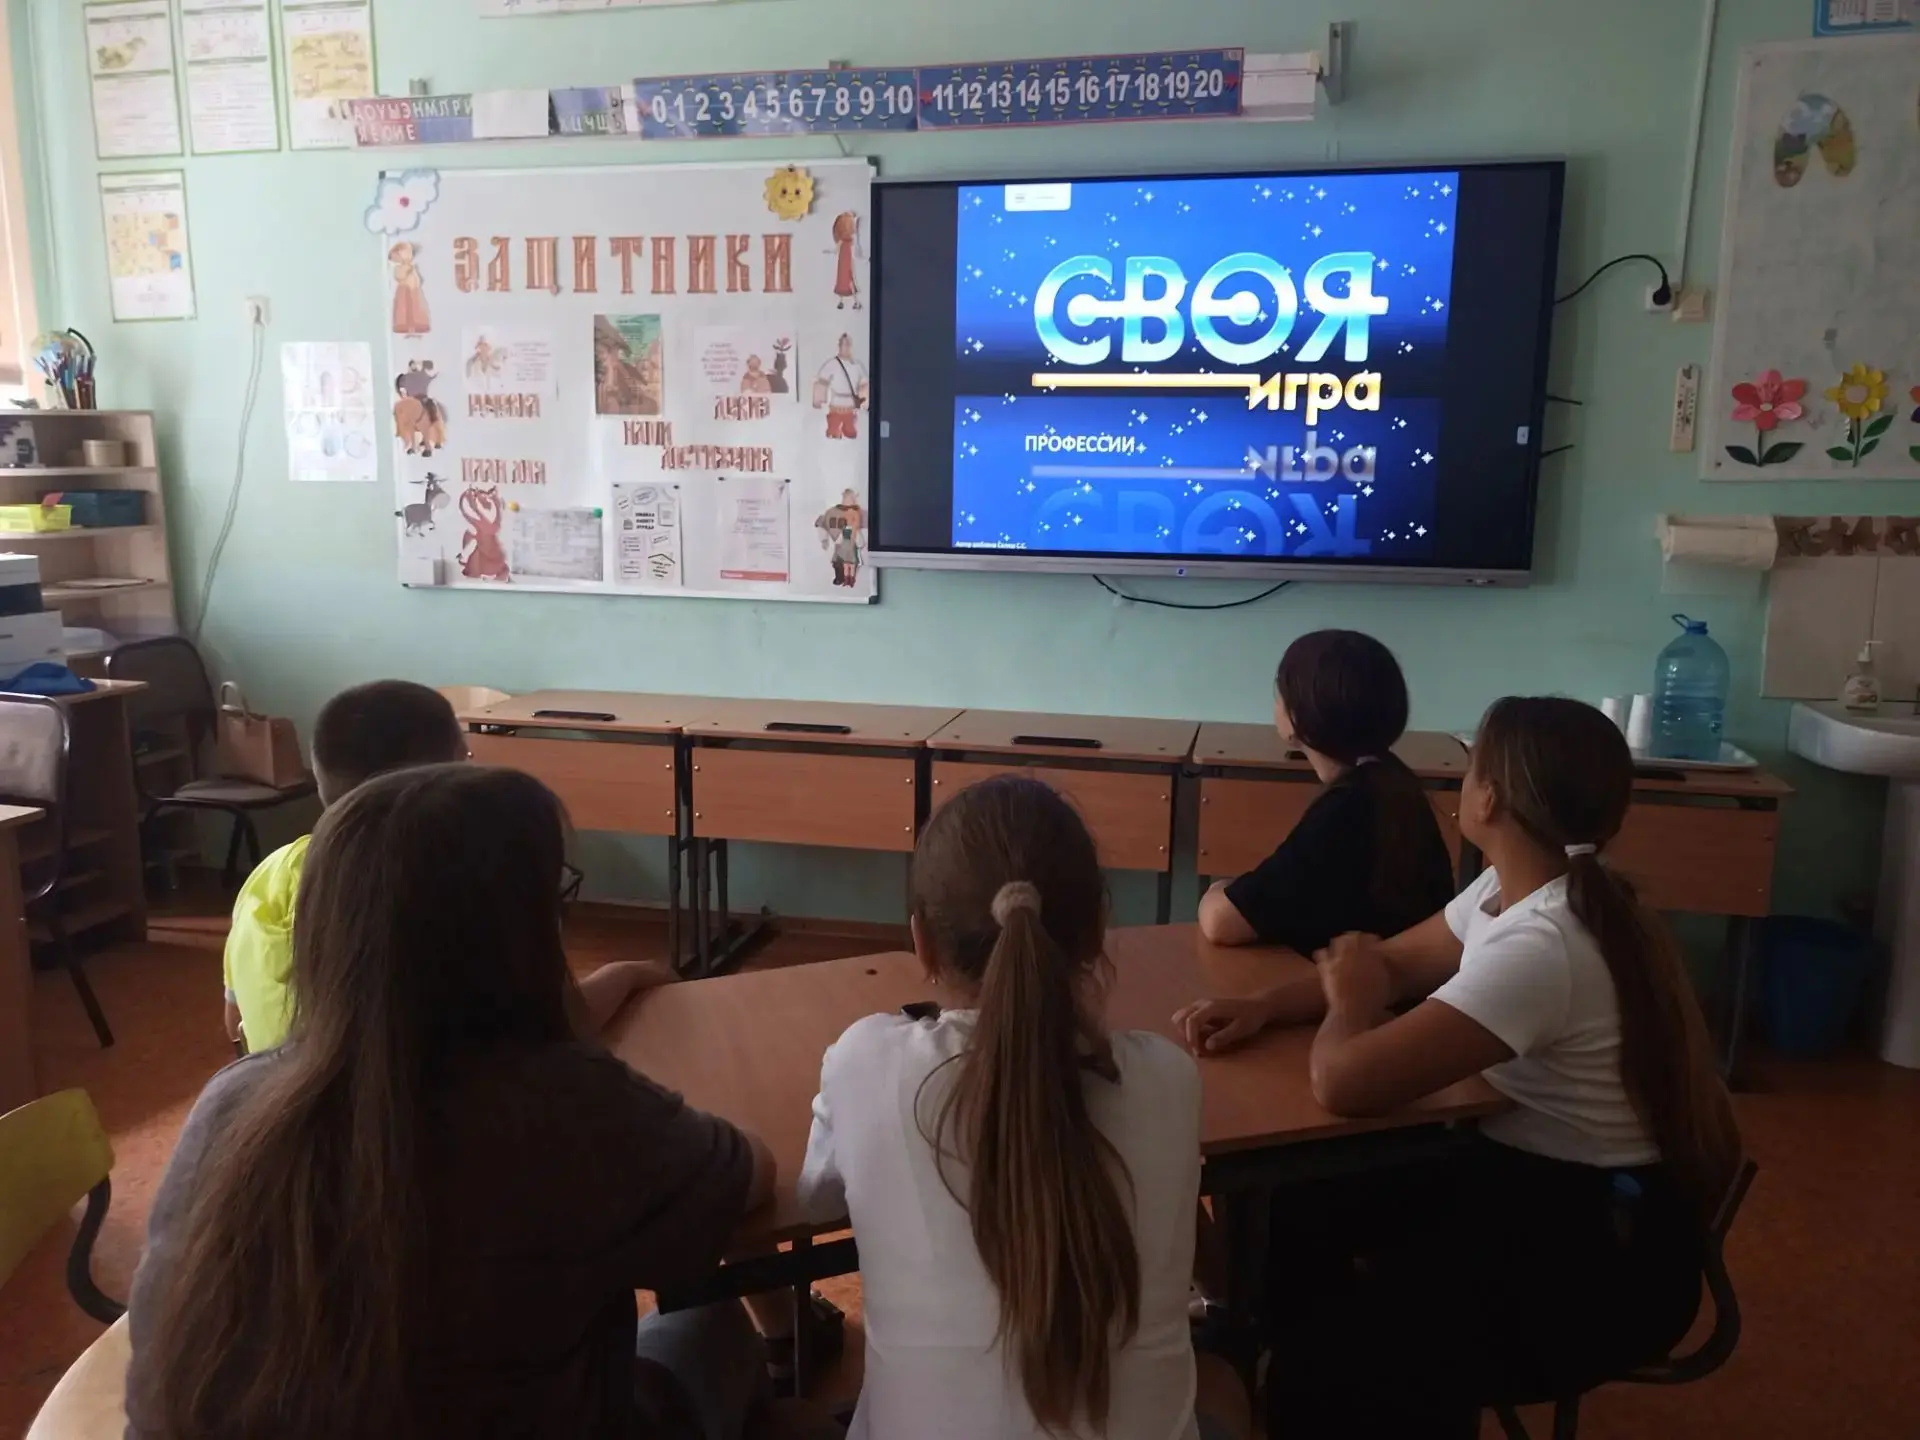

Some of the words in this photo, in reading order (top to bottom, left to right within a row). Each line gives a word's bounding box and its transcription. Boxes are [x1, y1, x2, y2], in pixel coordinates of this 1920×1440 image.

[652, 95, 667, 123] 0
[674, 94, 686, 122] 1
[696, 93, 711, 121] 2
[719, 92, 735, 120] 3
[743, 90, 758, 118] 4
[766, 90, 781, 118] 5
[789, 88, 804, 117] 6
[811, 88, 826, 116] 7
[835, 87, 850, 116] 8
[859, 86, 875, 115] 9
[883, 85, 914, 115] 10
[932, 83, 954, 111] 11
[958, 82, 983, 110] 12
[987, 80, 1012, 108] 13
[1015, 79, 1041, 107] 14
[1045, 77, 1070, 106] 15
[1074, 75, 1100, 104] 16
[1104, 74, 1131, 102] 17
[1134, 72, 1160, 101] 18
[1163, 70, 1189, 99] 19
[1194, 69, 1223, 98] 20
[453, 234, 794, 296] ЗАЩИТНИКИ
[1033, 251, 1390, 366] СВОЯ
[1247, 371, 1382, 426] игра
[623, 420, 673, 446] НАШИ
[1025, 434, 1136, 453] ПРОФЕССИИ
[461, 457, 507, 484] ПЛАН
